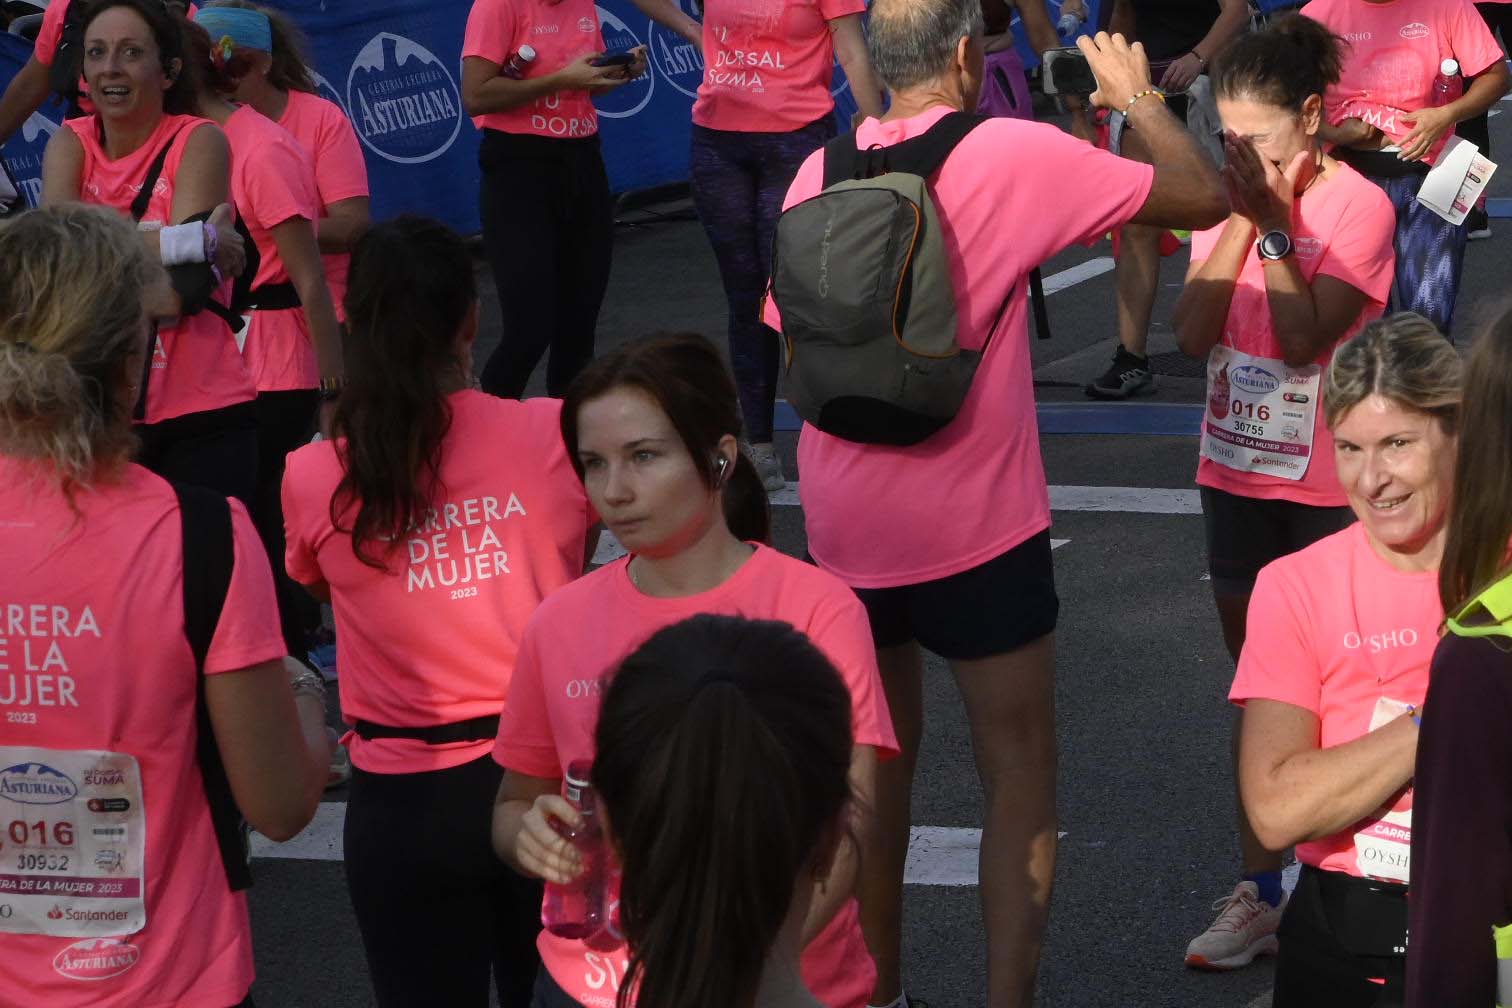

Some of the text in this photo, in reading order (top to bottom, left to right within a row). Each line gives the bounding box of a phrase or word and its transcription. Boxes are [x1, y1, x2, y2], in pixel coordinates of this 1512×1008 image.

[1343, 32, 1371, 41] YSHO
[716, 50, 785, 69] DORSAL
[357, 87, 457, 137] ASTURIANA
[1234, 373, 1276, 390] ASTURIANA
[1231, 399, 1270, 422] 016
[1234, 420, 1264, 436] 30755
[1211, 428, 1235, 442] CARRERA
[1235, 436, 1245, 444] DE
[1246, 438, 1254, 446] LA
[1255, 440, 1280, 451] MUJER
[1262, 456, 1300, 471] Santander
[375, 492, 527, 542] RRERA
[408, 524, 502, 564] DE LA
[408, 551, 511, 592] MUJER
[451, 587, 478, 600] 2023
[0, 604, 102, 637] RERA
[24, 639, 68, 672] LA
[6, 711, 37, 724] 2023
[0, 777, 71, 795] ASTURIANA
[84, 776, 124, 785] SUMA
[9, 820, 74, 846] 016
[20, 880, 33, 890] DE
[36, 881, 50, 891] LA
[54, 881, 94, 892] MUJER
[65, 908, 128, 922] Santander
[60, 952, 134, 970] ASTURIANA
